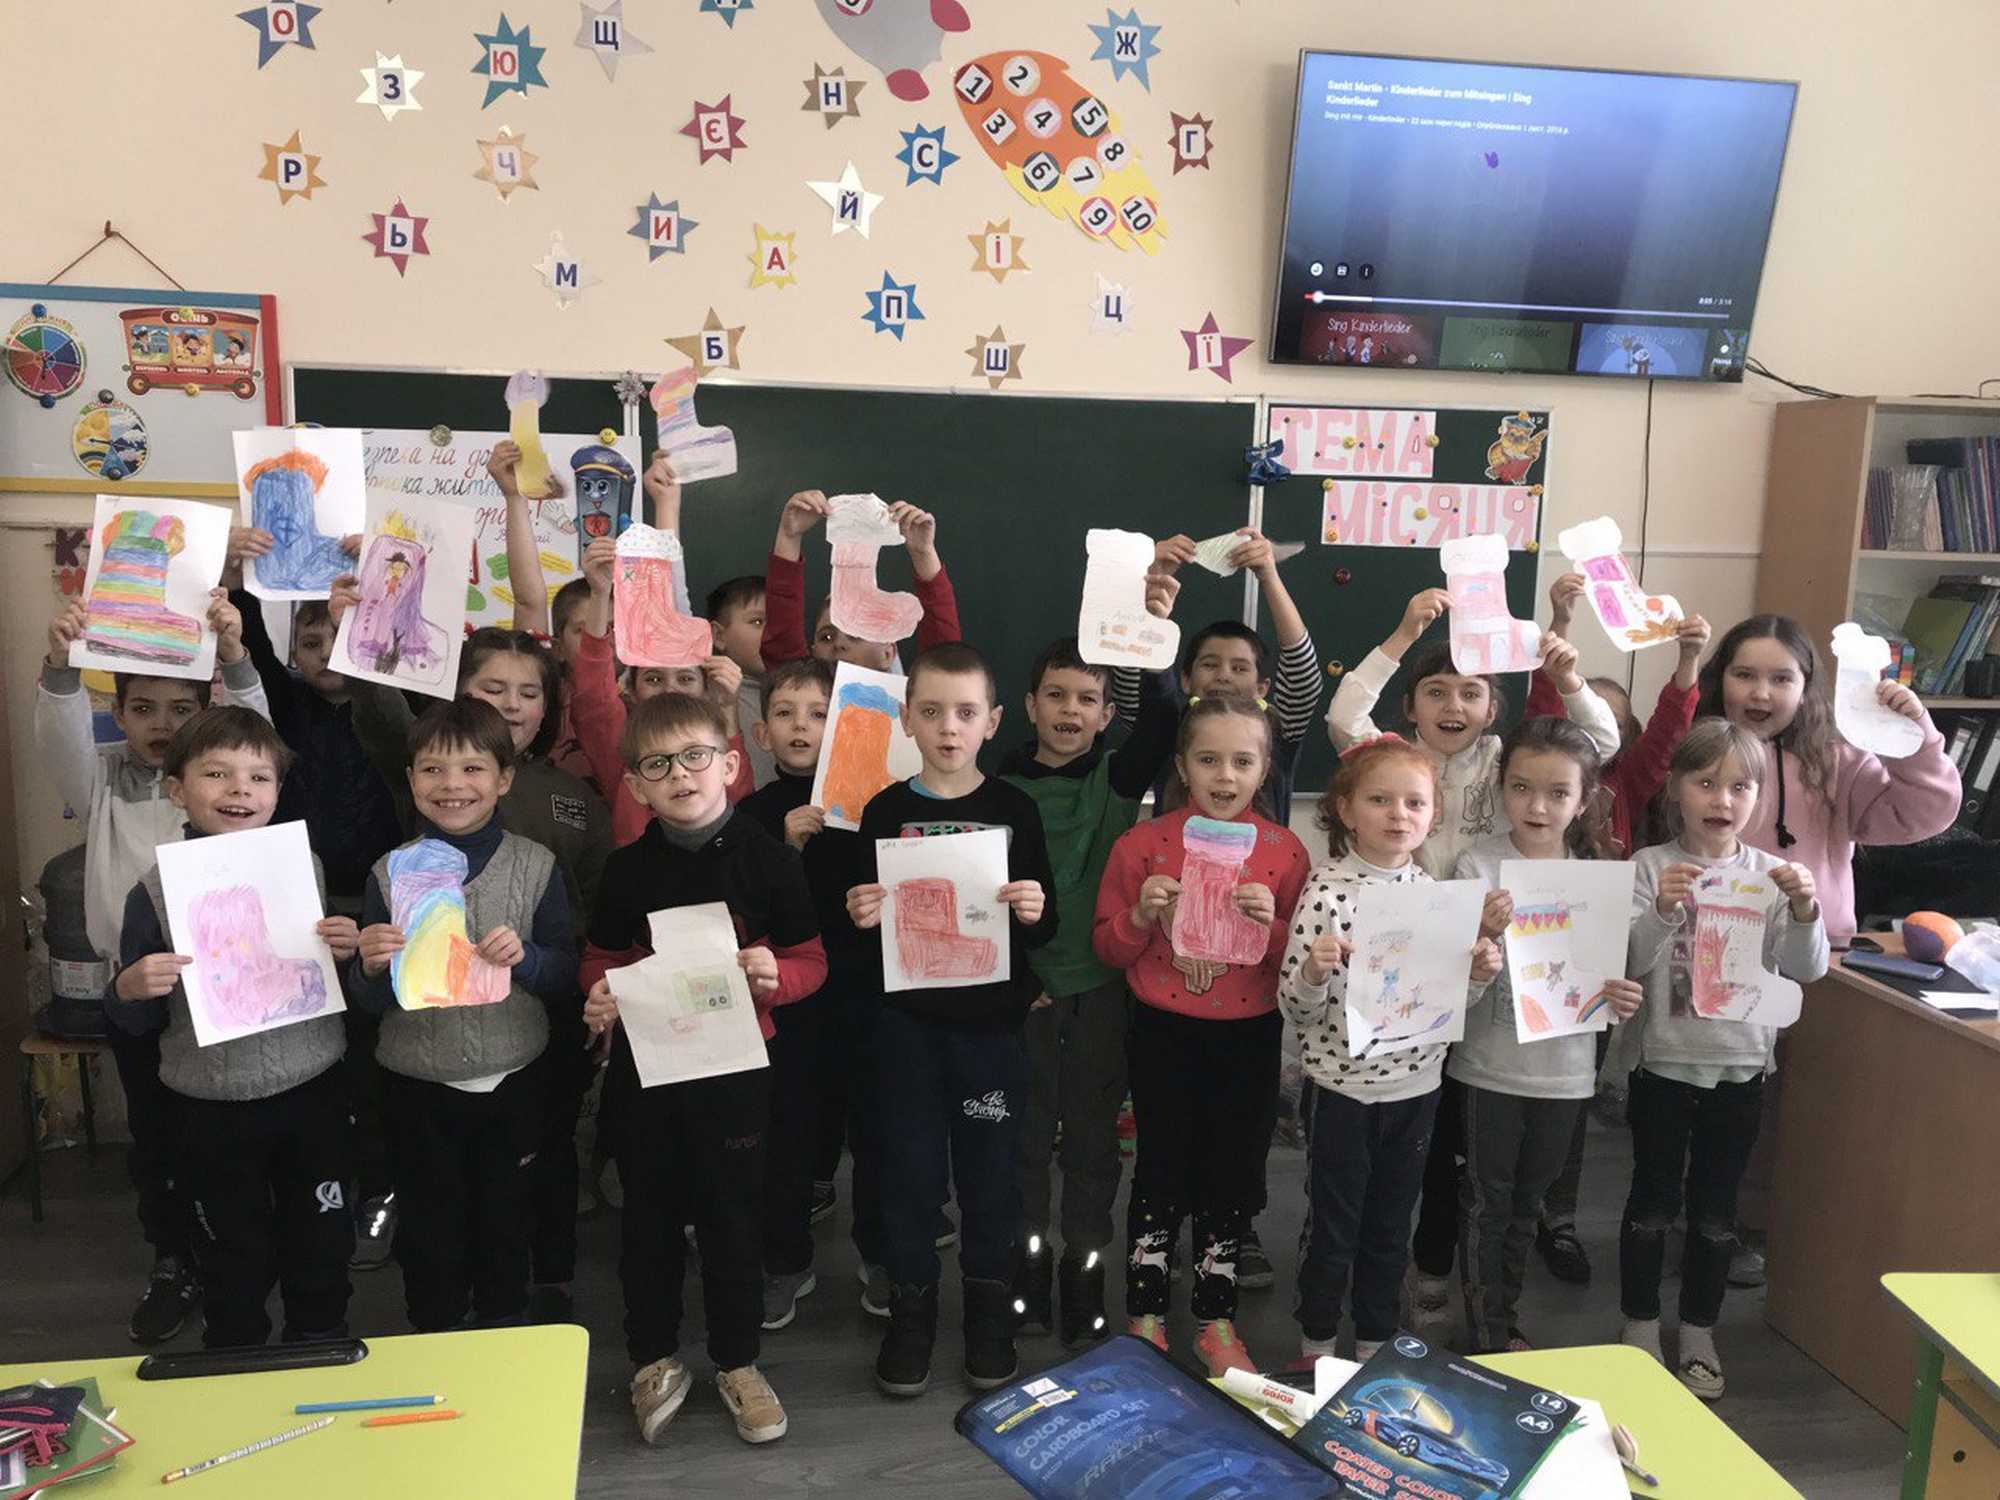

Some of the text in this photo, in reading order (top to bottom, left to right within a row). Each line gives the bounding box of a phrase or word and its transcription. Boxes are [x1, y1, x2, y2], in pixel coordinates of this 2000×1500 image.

[271, 8, 295, 36] О
[594, 20, 619, 51] Щ
[1117, 31, 1139, 56] Ж
[491, 50, 518, 76] Ю
[966, 77, 984, 98] 1
[1009, 65, 1028, 88] 2
[825, 83, 842, 105] Н
[1326, 95, 1379, 107] Kinderlieder
[1328, 80, 1353, 91] Sankt
[1355, 81, 1382, 93] Martin
[1391, 84, 1442, 97] Kinderlieder
[1444, 90, 1463, 98] zum
[1463, 89, 1506, 102] Mitsingen
[1512, 92, 1532, 105] Sing
[986, 114, 1006, 135] 3
[1034, 110, 1053, 129] 4
[1081, 106, 1101, 126] 5
[707, 118, 722, 143] Є
[917, 144, 934, 168] С
[1105, 142, 1124, 161] 8
[283, 159, 302, 184] Р
[1031, 161, 1051, 180] 6
[1073, 166, 1094, 183] 7
[841, 191, 859, 221] Й
[1088, 207, 1107, 226] 9
[1123, 200, 1151, 231] 10
[655, 215, 673, 241] И
[766, 246, 785, 272] А
[556, 263, 578, 288] М
[170, 312, 209, 324] ОНЬ
[885, 295, 903, 319] П
[1105, 296, 1124, 322] Ц
[1327, 317, 1414, 335] Sing Kinderlieder
[706, 338, 724, 361] Б
[987, 348, 1009, 373] Ш
[1271, 408, 1432, 474] ТЕМА
[1540, 1394, 1563, 1410] 14
[1519, 1415, 1550, 1431] A4
[1015, 1414, 1070, 1458] COLOR
[1030, 1408, 1121, 1471] CARDBOARD
